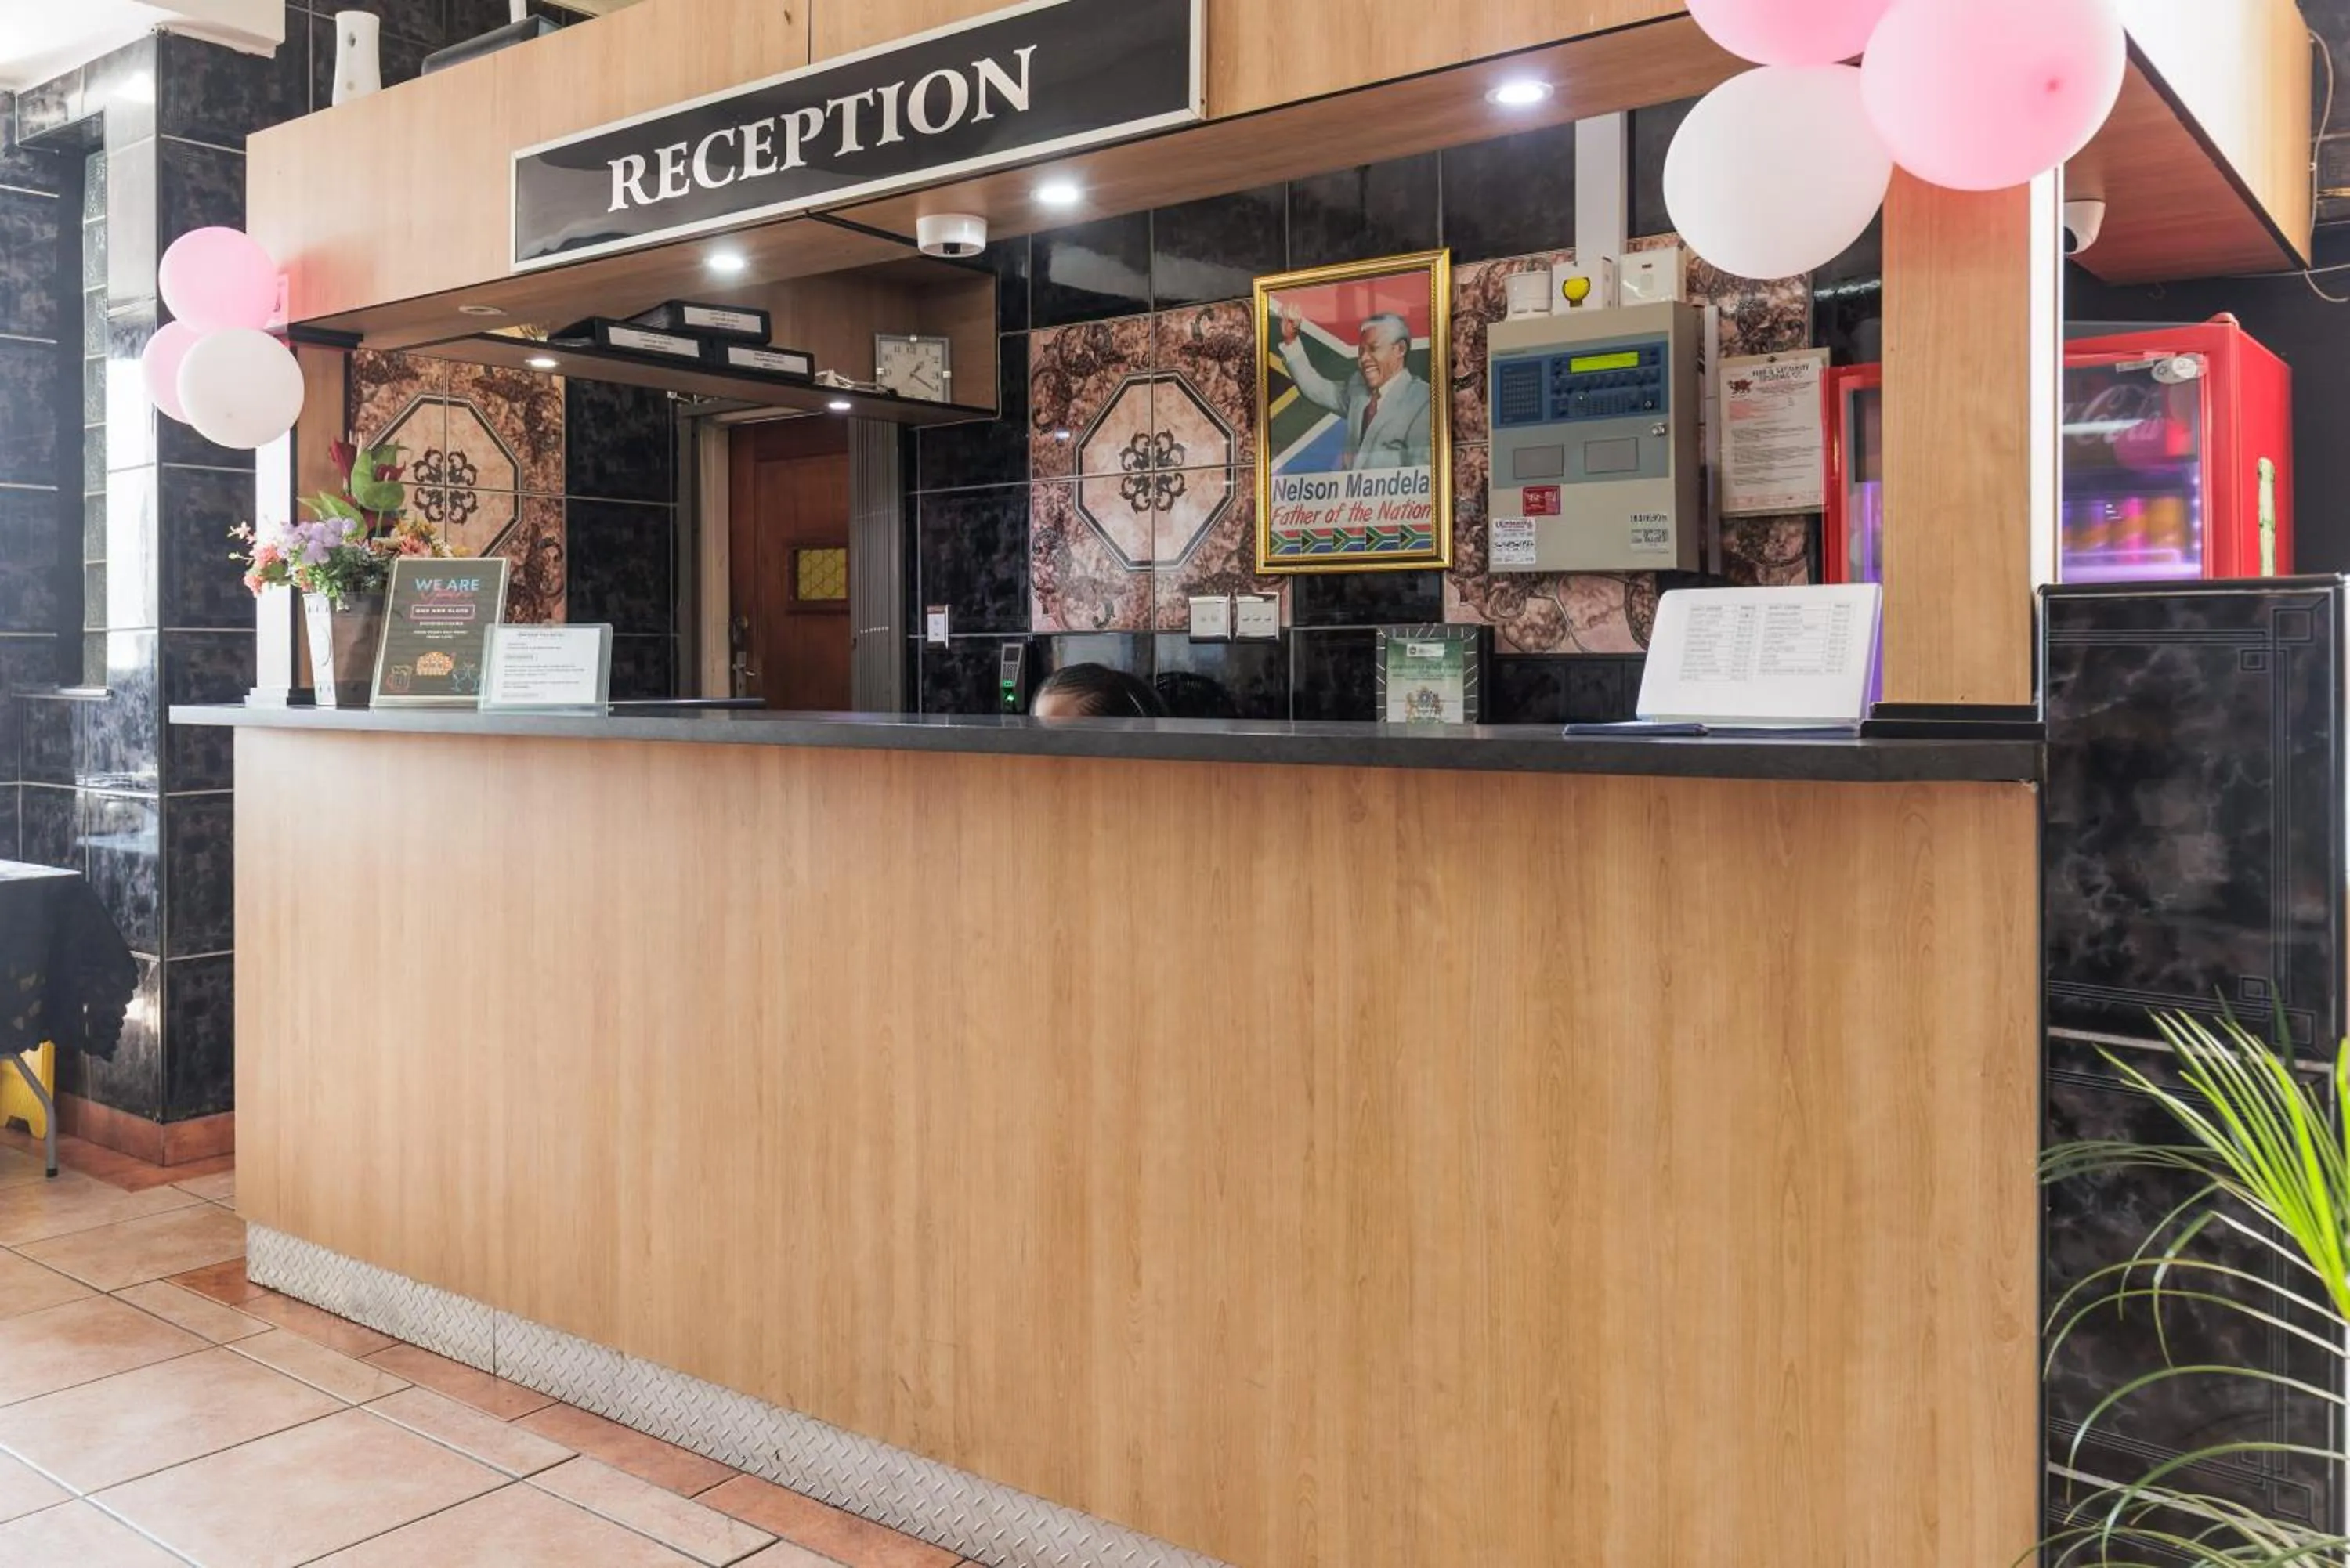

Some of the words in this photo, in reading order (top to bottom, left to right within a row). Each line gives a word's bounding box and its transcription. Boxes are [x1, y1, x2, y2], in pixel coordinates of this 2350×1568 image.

[607, 44, 1037, 214] RECEPTION
[1273, 477, 1339, 502] Nelson
[1345, 470, 1430, 498] Mandela
[1271, 504, 1322, 526] Father
[1325, 502, 1346, 524] of
[1348, 501, 1372, 522] the
[1378, 499, 1431, 520] Nation
[415, 578, 443, 591] WE
[446, 578, 480, 592] ARE
